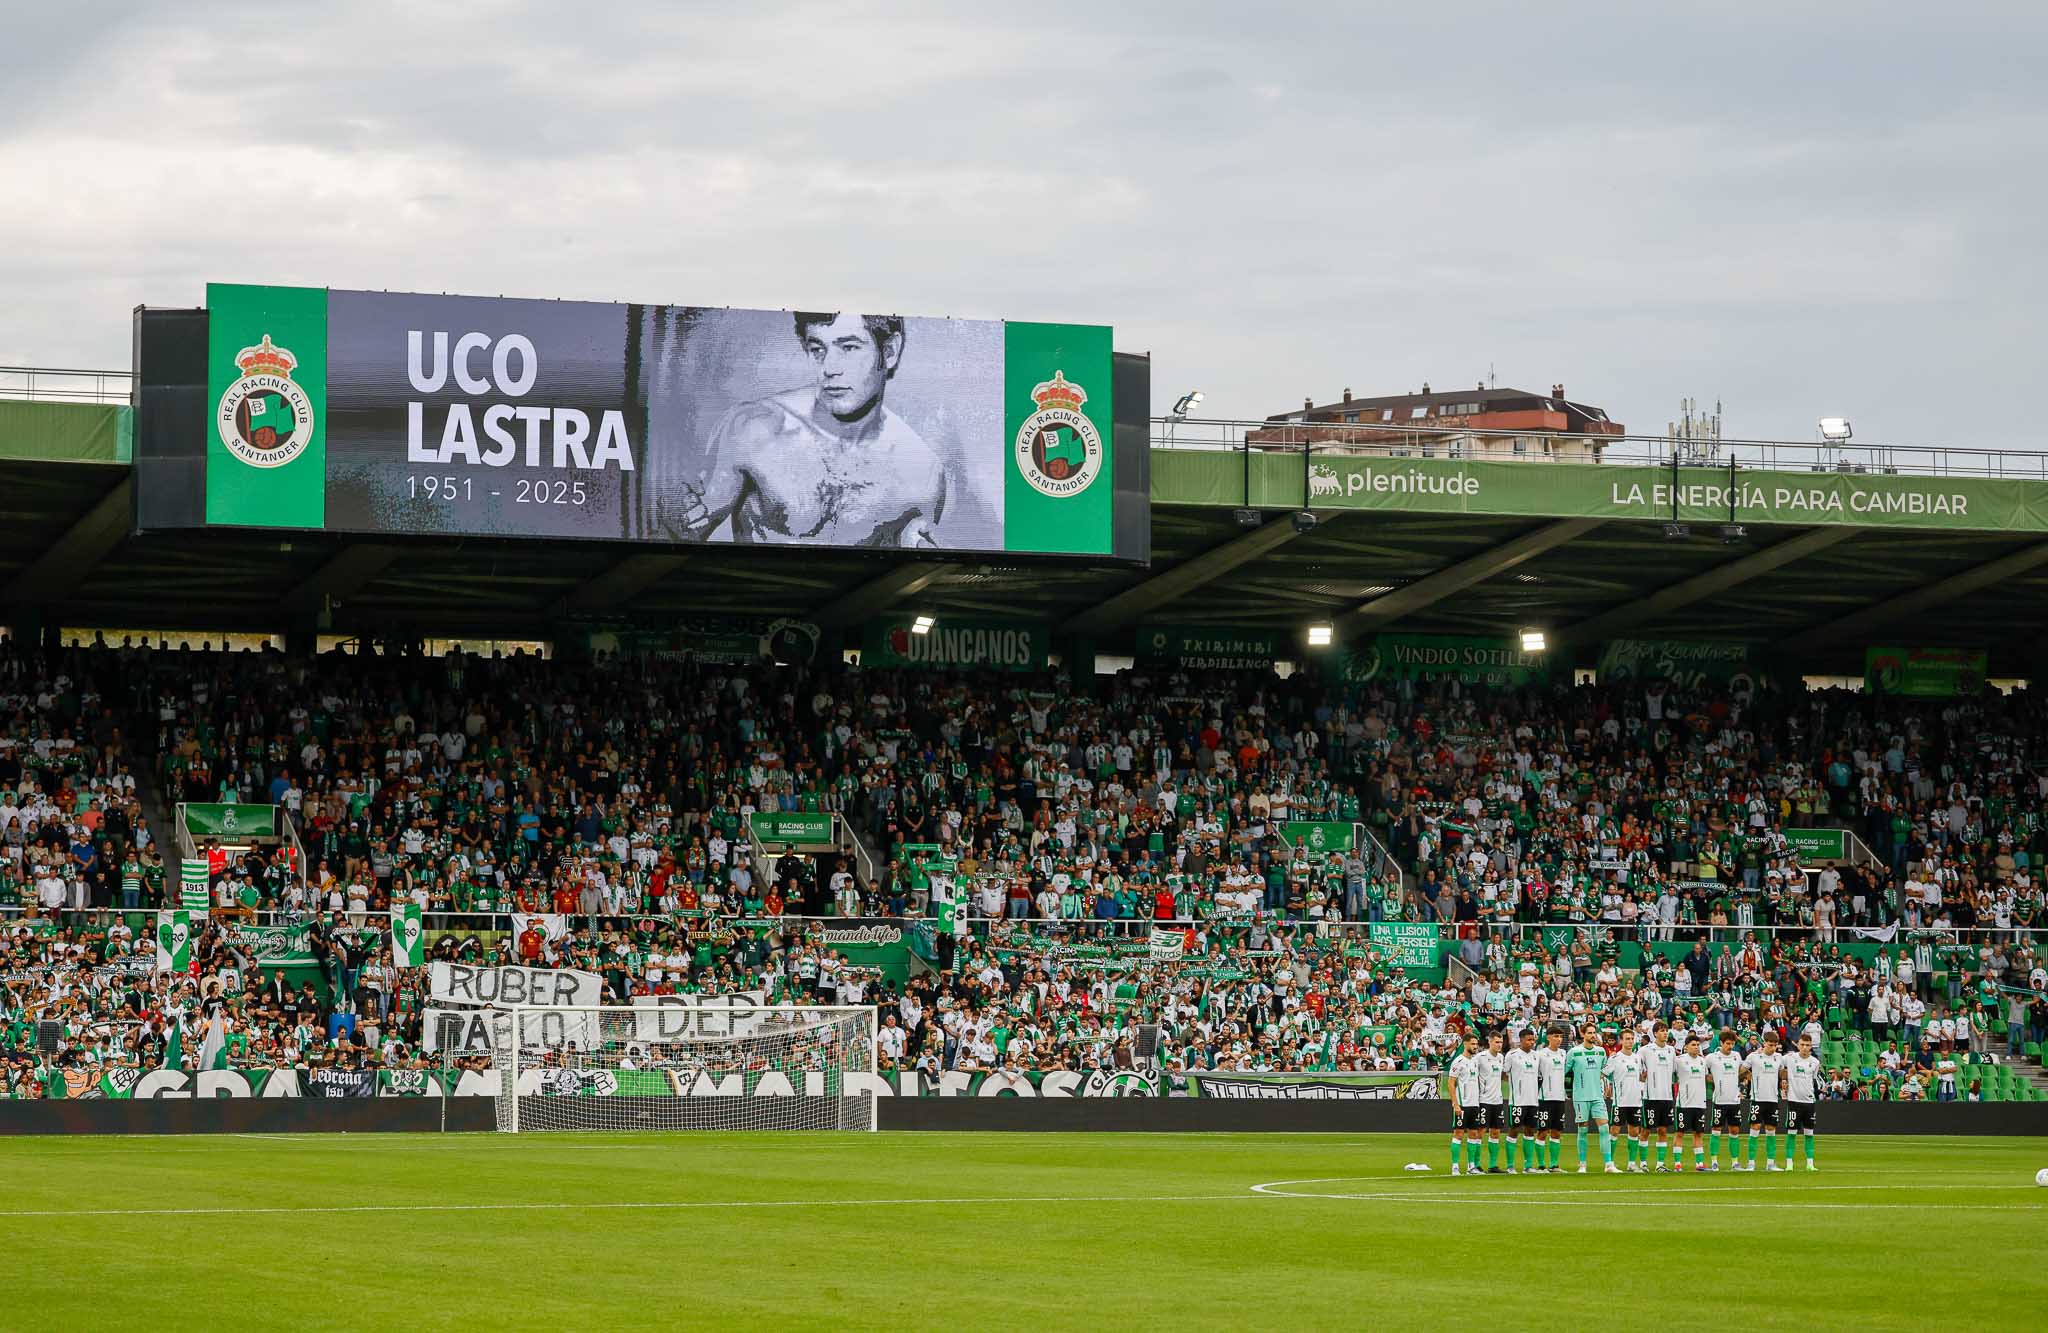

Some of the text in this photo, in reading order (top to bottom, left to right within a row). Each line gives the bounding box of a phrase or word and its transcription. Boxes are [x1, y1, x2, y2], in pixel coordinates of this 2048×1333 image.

[408, 331, 538, 397] UCO
[223, 377, 308, 424] REAL RACING CLUB
[408, 402, 635, 471] LASTRA
[1020, 412, 1097, 456] REAL RACING CLUB
[232, 438, 293, 462] SANTANDER
[407, 475, 472, 502] 1951
[516, 480, 586, 505] 2025
[1028, 469, 1089, 493] SANTANDER
[1347, 467, 1479, 497] plenitude
[1613, 482, 1967, 516] LA ENERGÍA PARA CAMBIAR
[1393, 643, 1457, 664] VINDIO
[186, 884, 204, 892] 1913
[1373, 926, 1391, 936] UNA
[449, 964, 580, 1007] RUBER
[1480, 1108, 1486, 1117] 2
[1512, 1107, 1522, 1116] 29
[1539, 1111, 1549, 1121] 36
[1647, 1109, 1655, 1119] 16
[1678, 1112, 1684, 1122] 8
[1751, 1105, 1760, 1115] 32
[1789, 1111, 1797, 1121] 10
